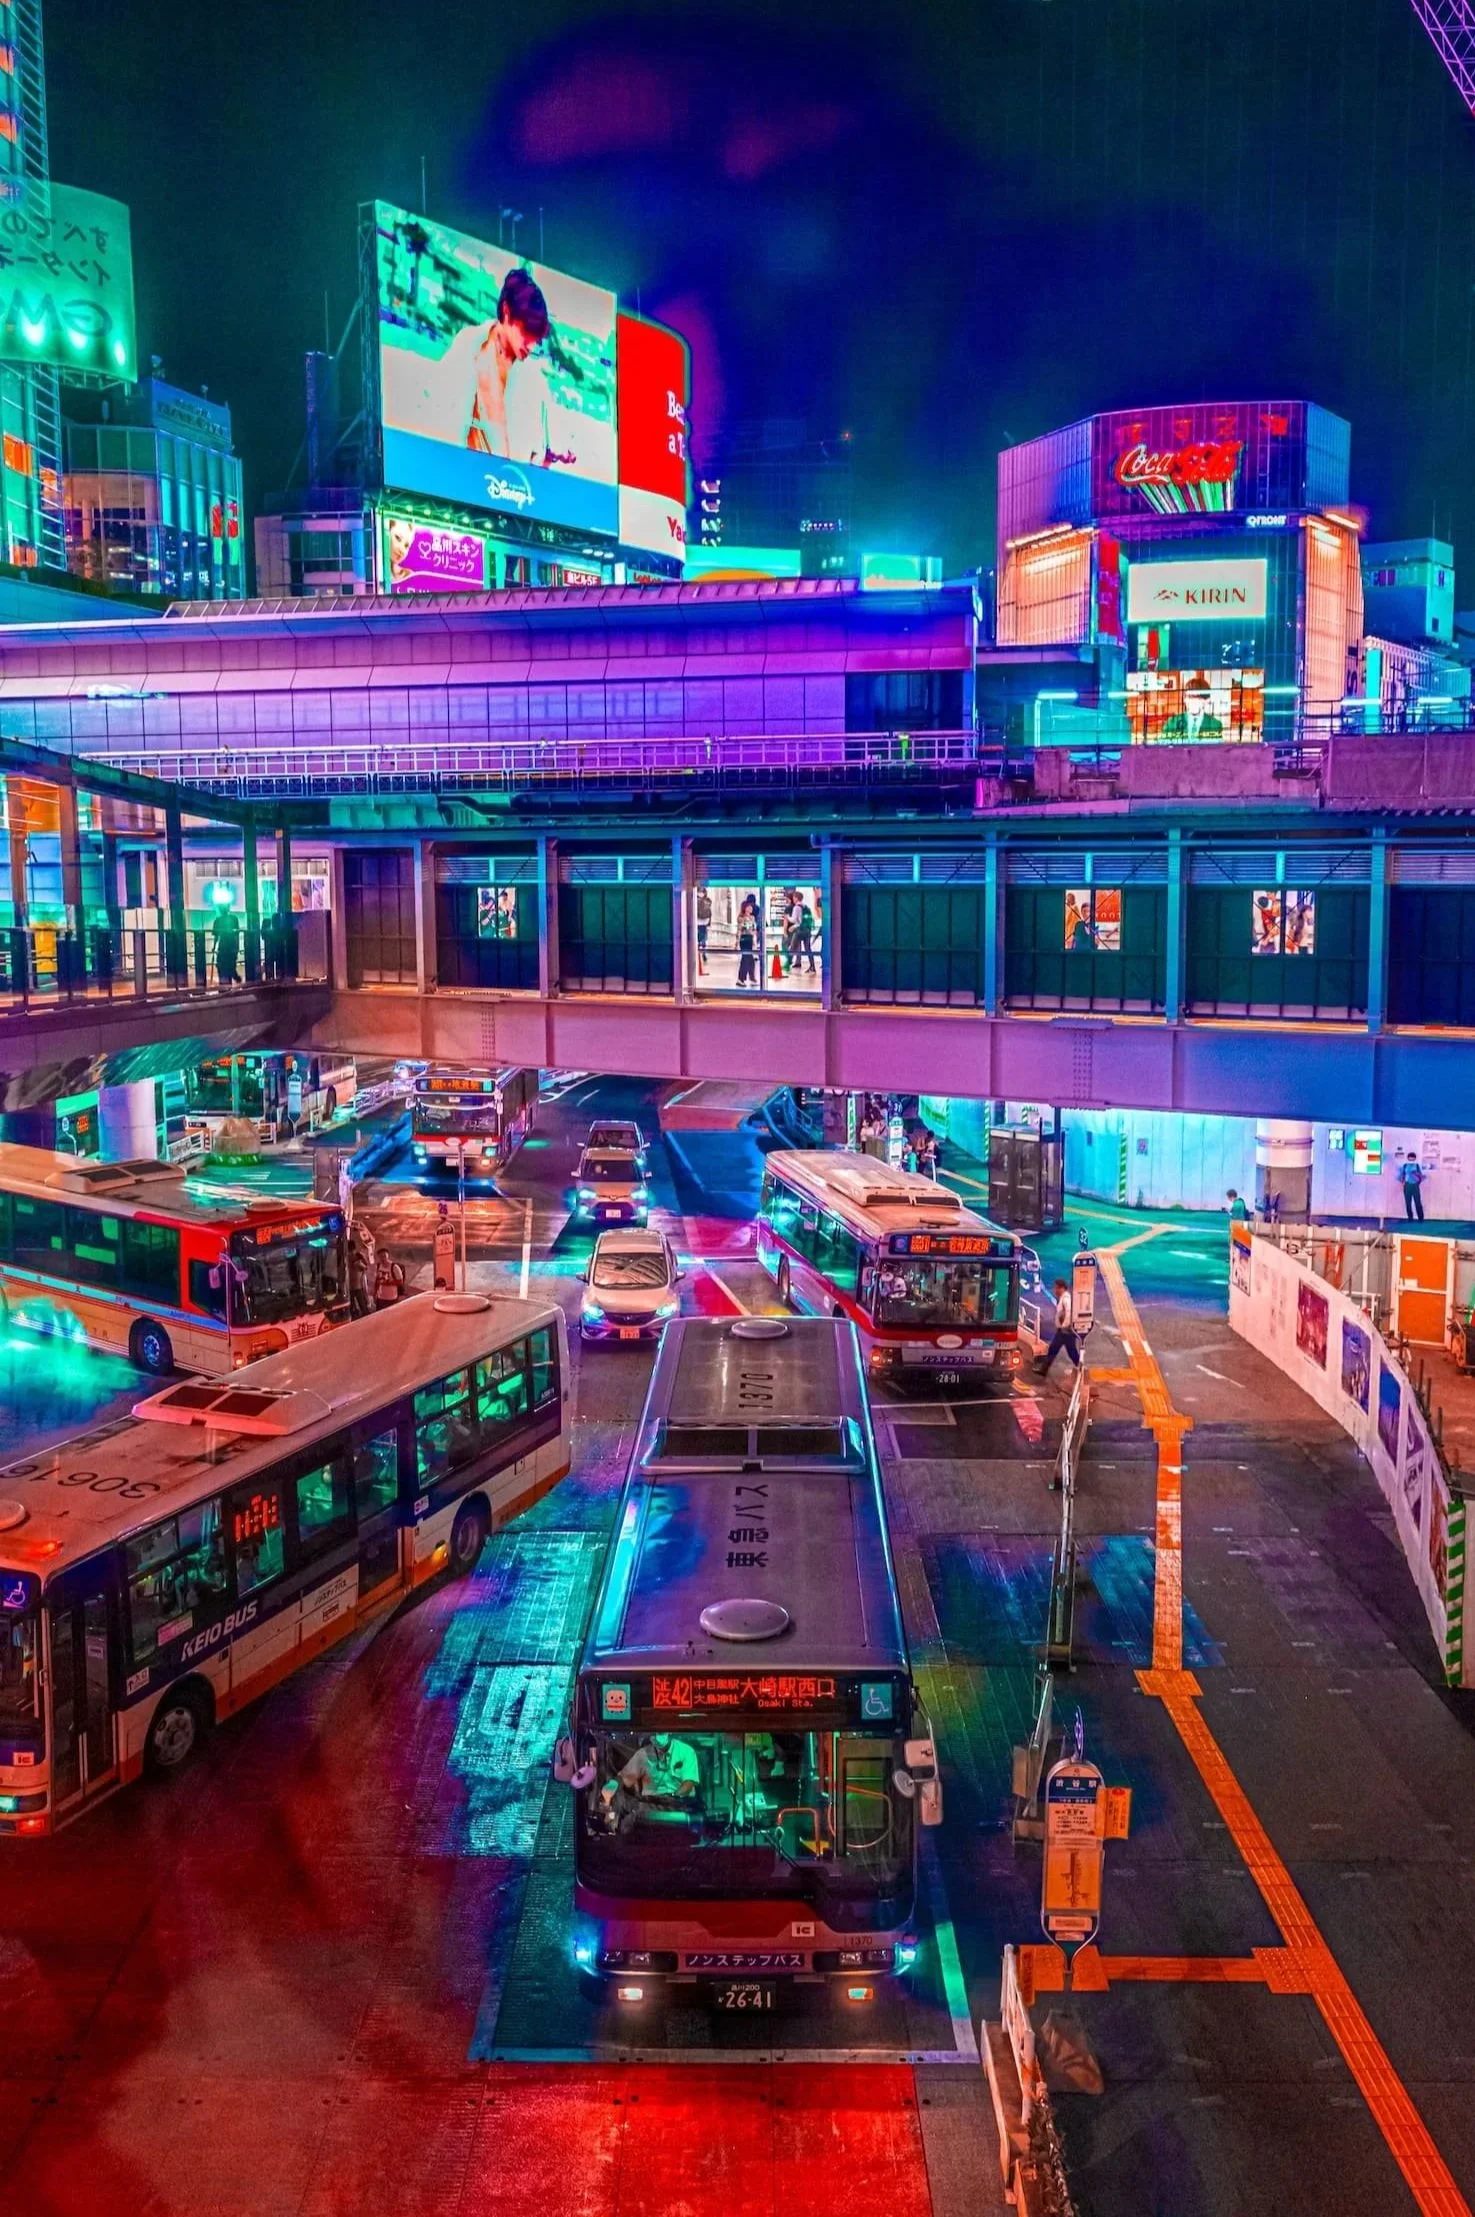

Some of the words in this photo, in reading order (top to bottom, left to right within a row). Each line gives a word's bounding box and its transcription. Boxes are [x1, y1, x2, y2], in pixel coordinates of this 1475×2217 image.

[1246, 515, 1287, 528] QFRONT
[431, 536, 479, 558] 品川スキン
[433, 553, 475, 574] クリニック
[1185, 587, 1246, 604] KIRIN
[1079, 1230, 1088, 1245] 32
[738, 1373, 774, 1409] 1370
[725, 1484, 770, 1569] 東急バス
[181, 1621, 222, 1662] KEIO
[222, 1601, 258, 1637] BUS
[655, 1678, 690, 1706] 渋42
[740, 1676, 836, 1699] 大崎駅西口
[757, 1698, 786, 1708] Osaki
[791, 1698, 814, 1708] Sta.
[688, 1954, 802, 1967] ノンステップバス
